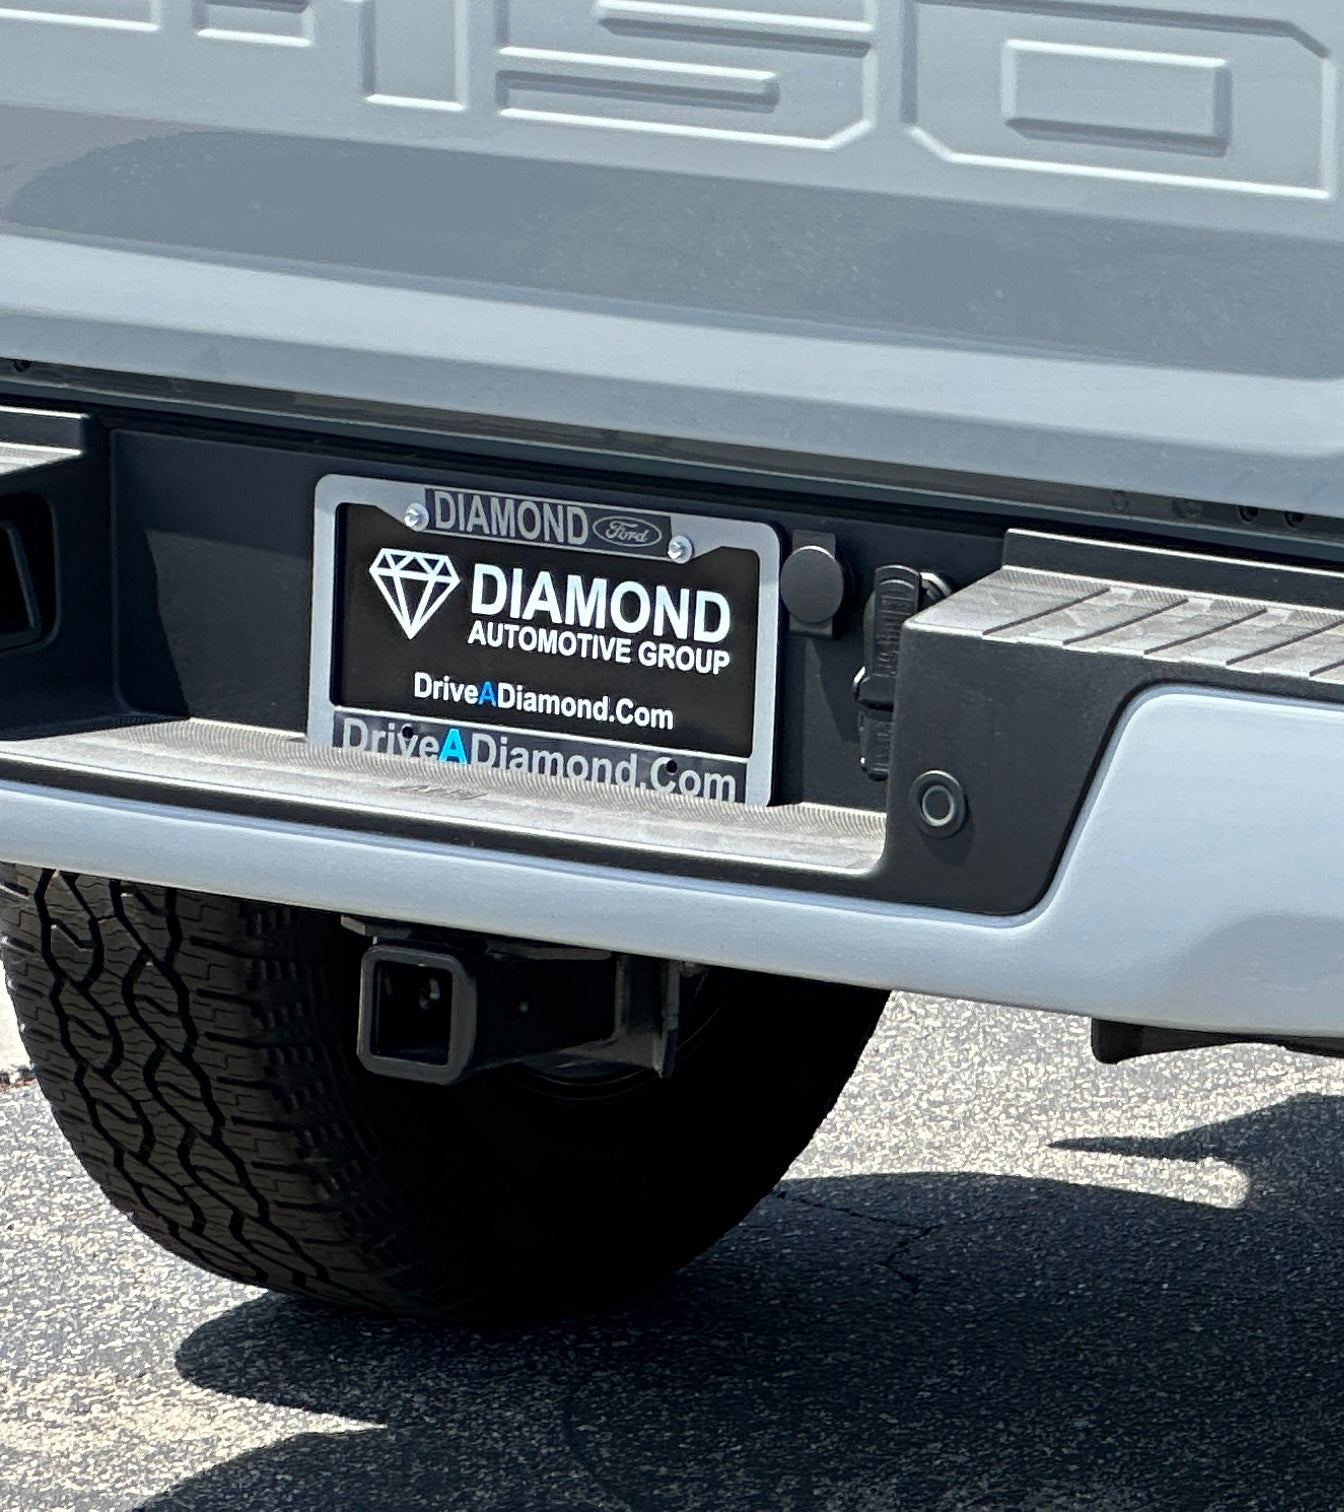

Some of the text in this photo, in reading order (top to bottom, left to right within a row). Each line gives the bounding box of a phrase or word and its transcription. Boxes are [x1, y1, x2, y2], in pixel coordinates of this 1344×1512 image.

[433, 490, 649, 546] DIAMOND Ford
[471, 562, 731, 644] DIAMOND
[468, 620, 731, 676] AUTOMOTIVE GROUP
[413, 671, 675, 731] DriveADiamond.Com
[342, 717, 738, 804] DriveADiamond.Com
